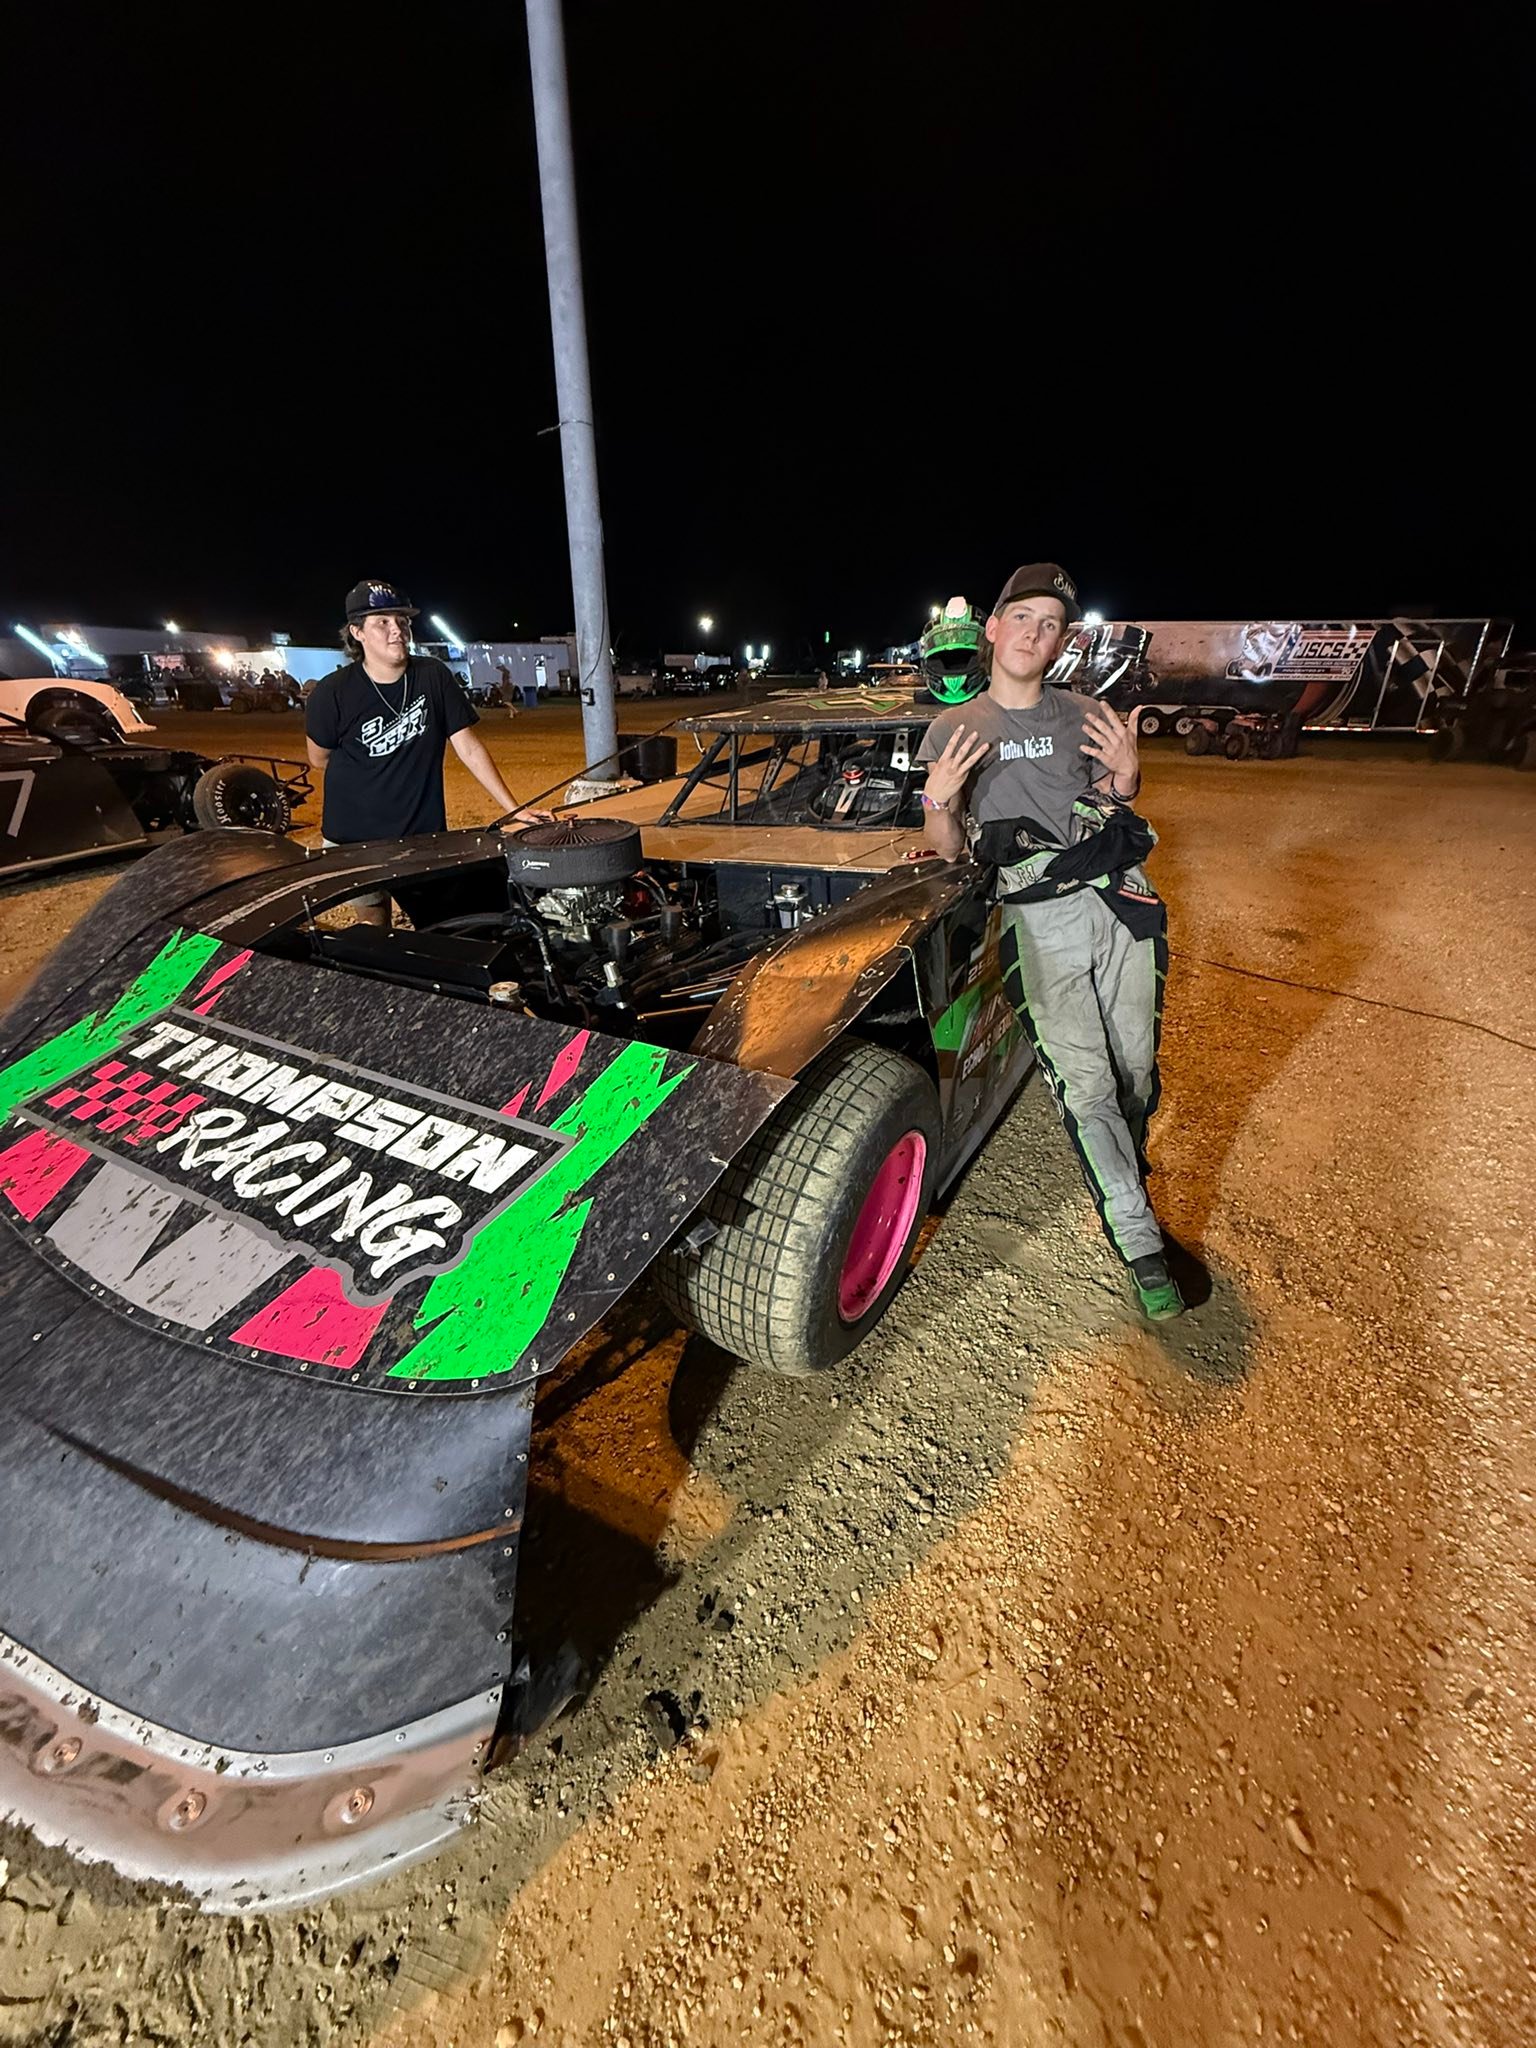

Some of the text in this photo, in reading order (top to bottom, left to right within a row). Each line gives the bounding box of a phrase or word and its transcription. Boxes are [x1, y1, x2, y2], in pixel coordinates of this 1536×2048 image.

[213, 779, 232, 824] Hoosier
[999, 736, 1054, 761] John 16:33
[128, 1020, 539, 1195] THOMPSON
[155, 1107, 464, 1280] RACING
